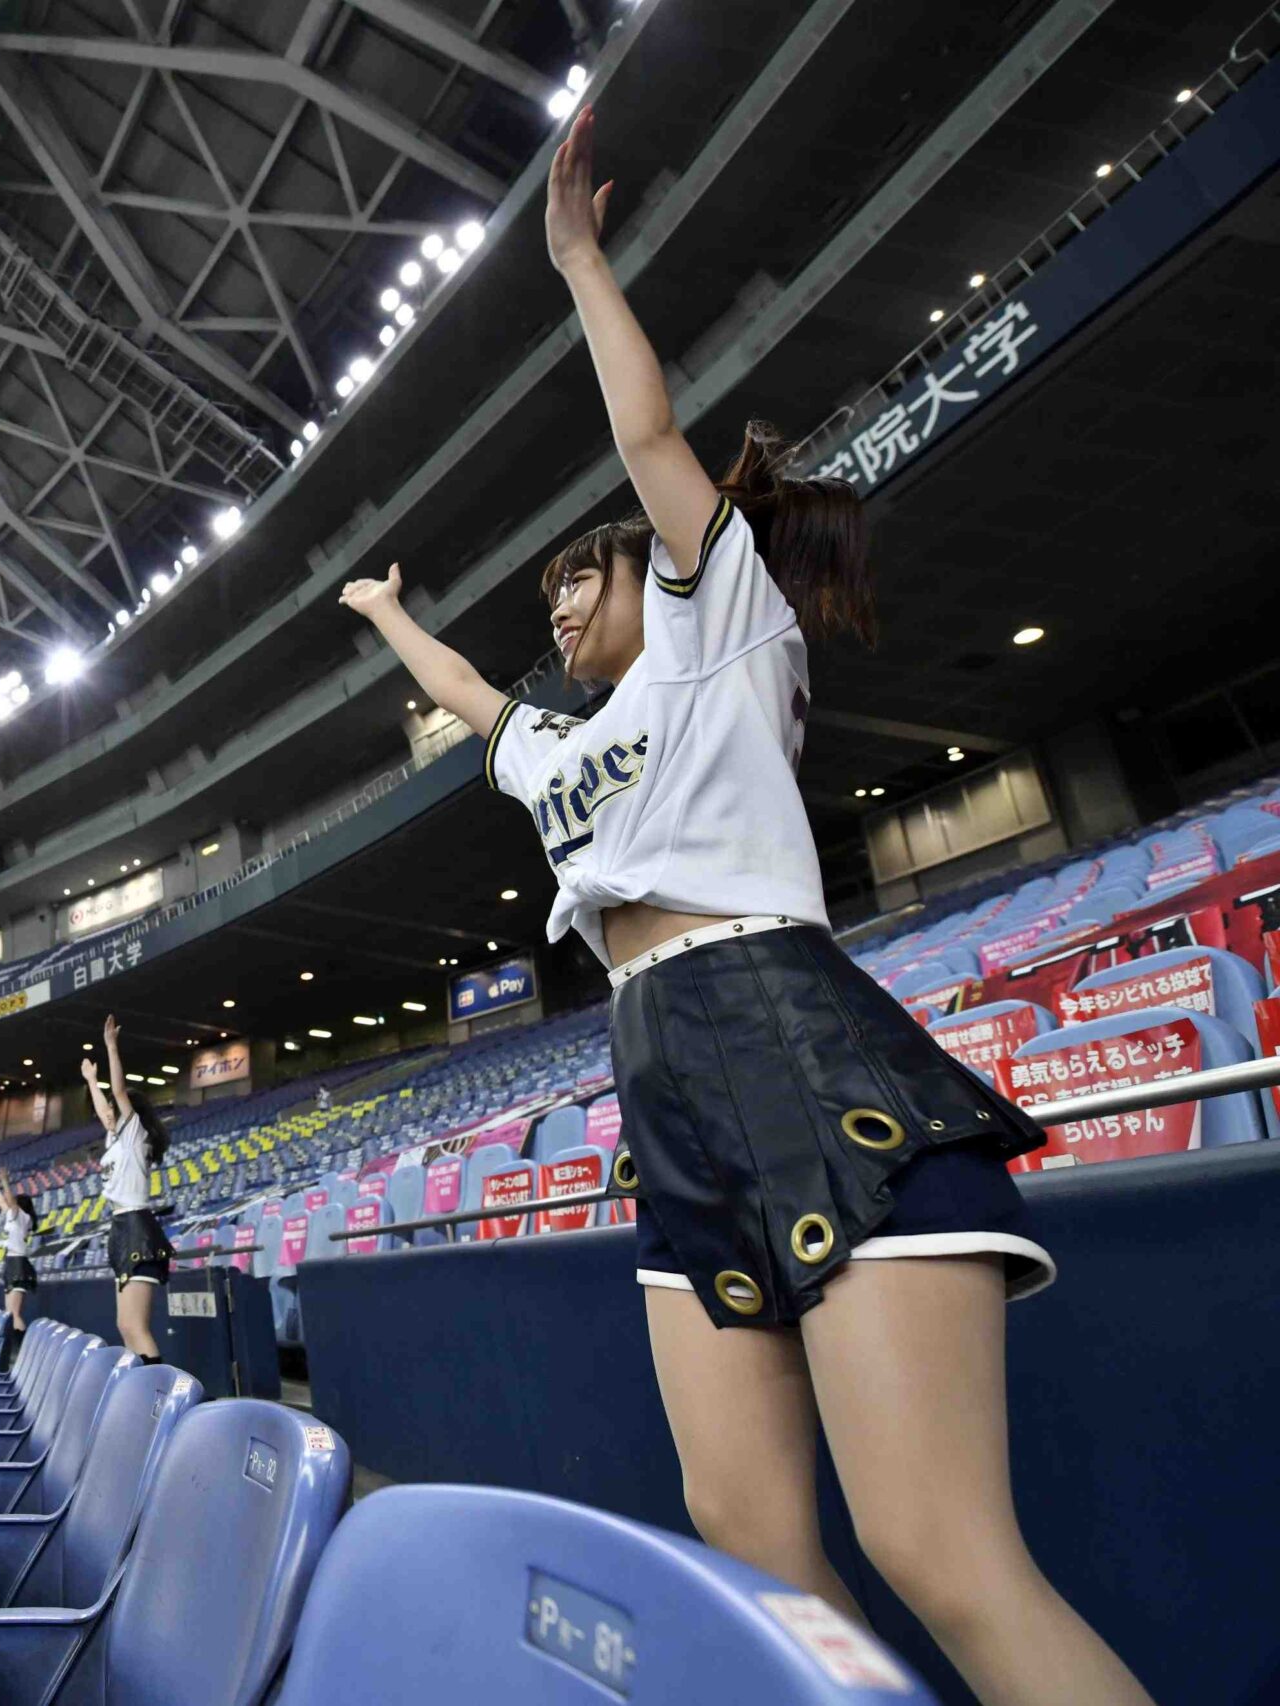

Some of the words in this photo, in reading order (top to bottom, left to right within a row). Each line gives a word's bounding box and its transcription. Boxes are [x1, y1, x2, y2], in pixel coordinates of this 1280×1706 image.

[500, 978, 525, 996] Pay
[195, 1056, 247, 1079] アイホン
[1010, 1033, 1186, 1088] 勇気もらえるピッチ
